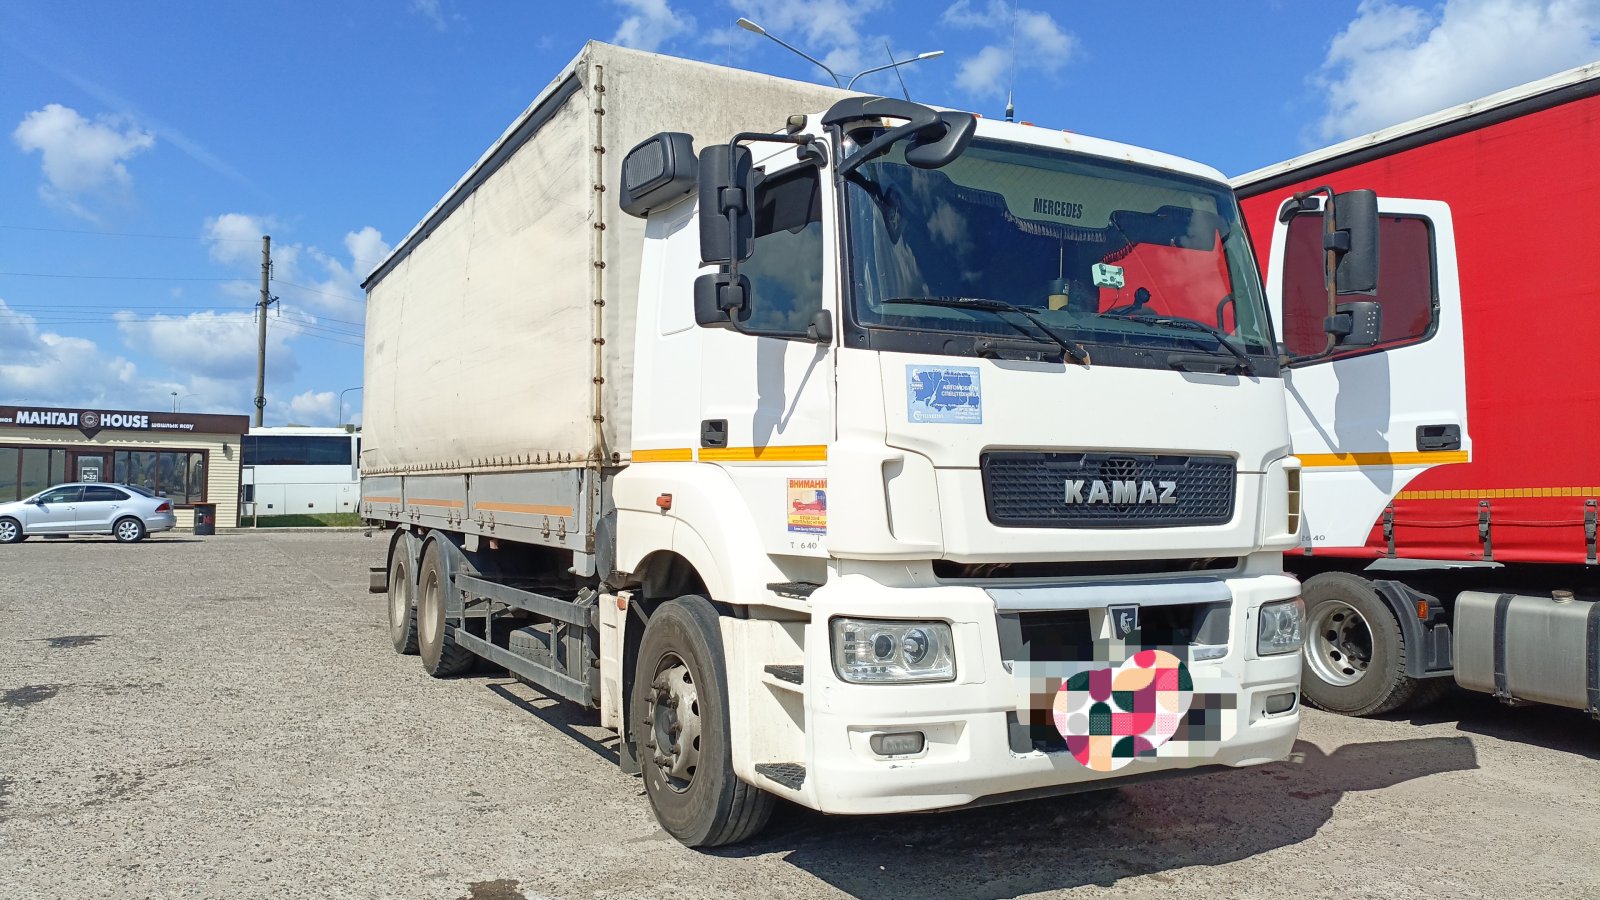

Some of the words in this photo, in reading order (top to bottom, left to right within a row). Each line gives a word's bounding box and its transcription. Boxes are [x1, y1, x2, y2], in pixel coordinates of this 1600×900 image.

[1033, 197, 1083, 219] MERCEDES
[15, 410, 78, 426] МАНГАЛ
[100, 413, 149, 428] HOUSE
[1064, 479, 1177, 504] KAMAZ
